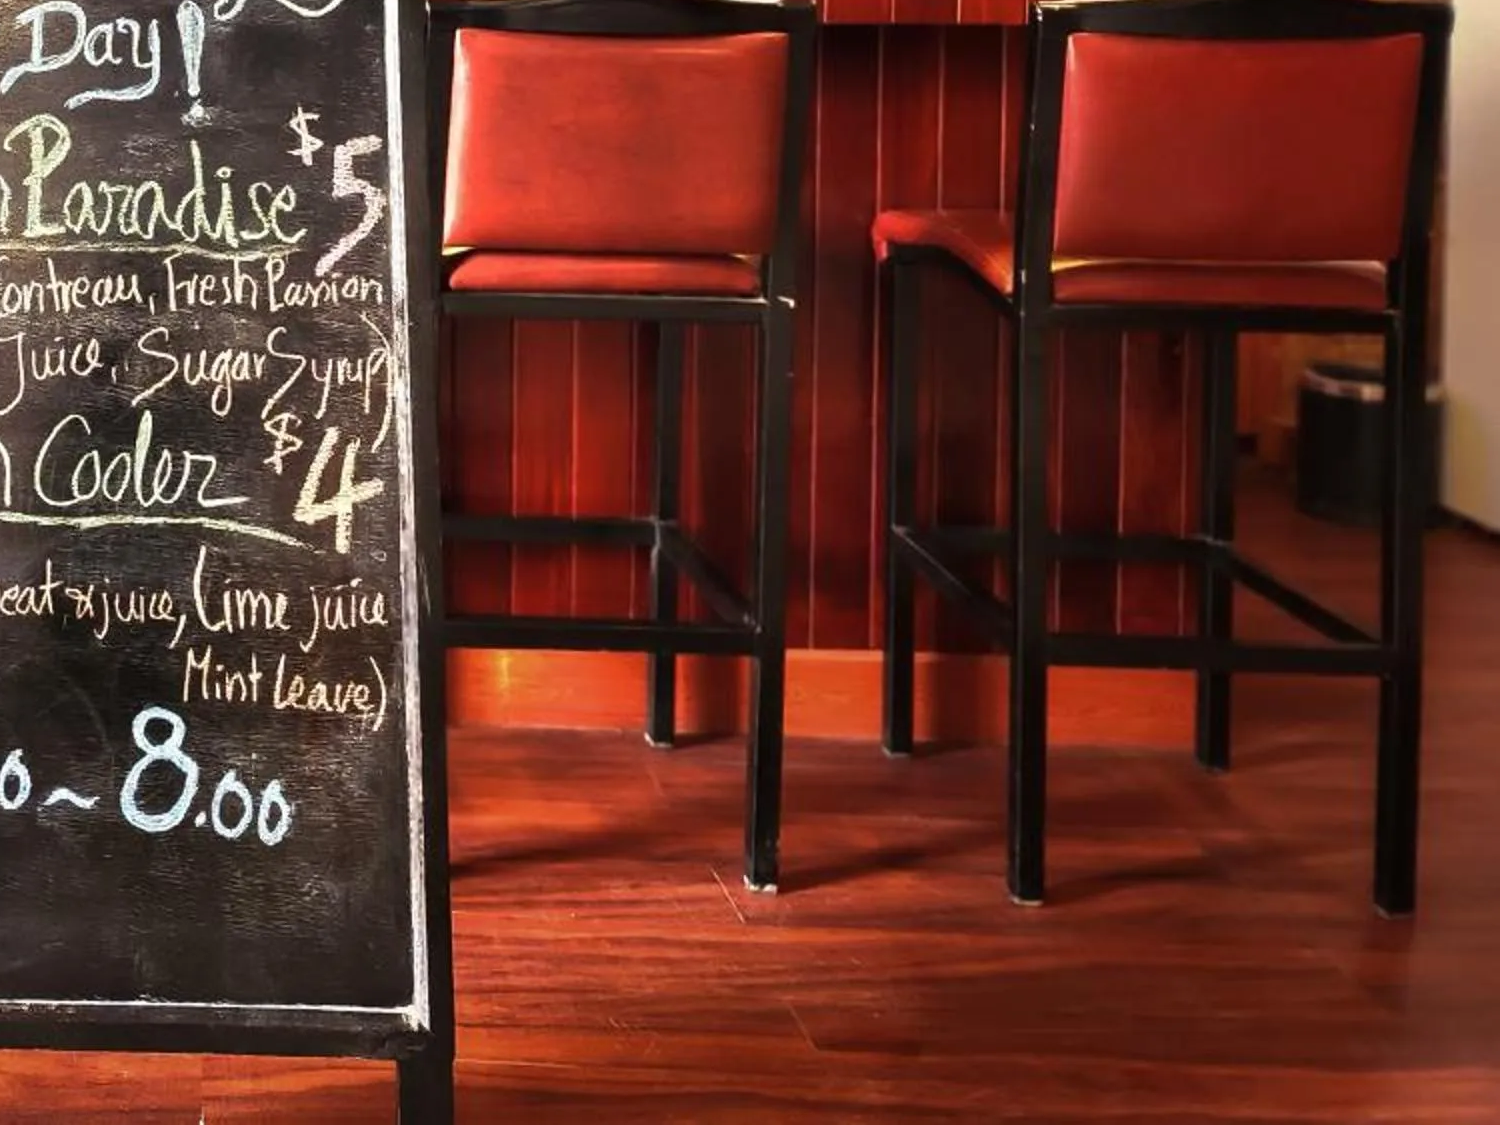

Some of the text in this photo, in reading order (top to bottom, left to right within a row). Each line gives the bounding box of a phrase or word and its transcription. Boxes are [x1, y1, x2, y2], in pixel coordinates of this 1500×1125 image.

[3, 113, 308, 249] Paradise
[164, 253, 256, 312] Fresh
[131, 327, 266, 416] Sugar
[33, 410, 250, 507] Cooler
[300, 578, 388, 653] juice
[183, 645, 262, 703] Mint
